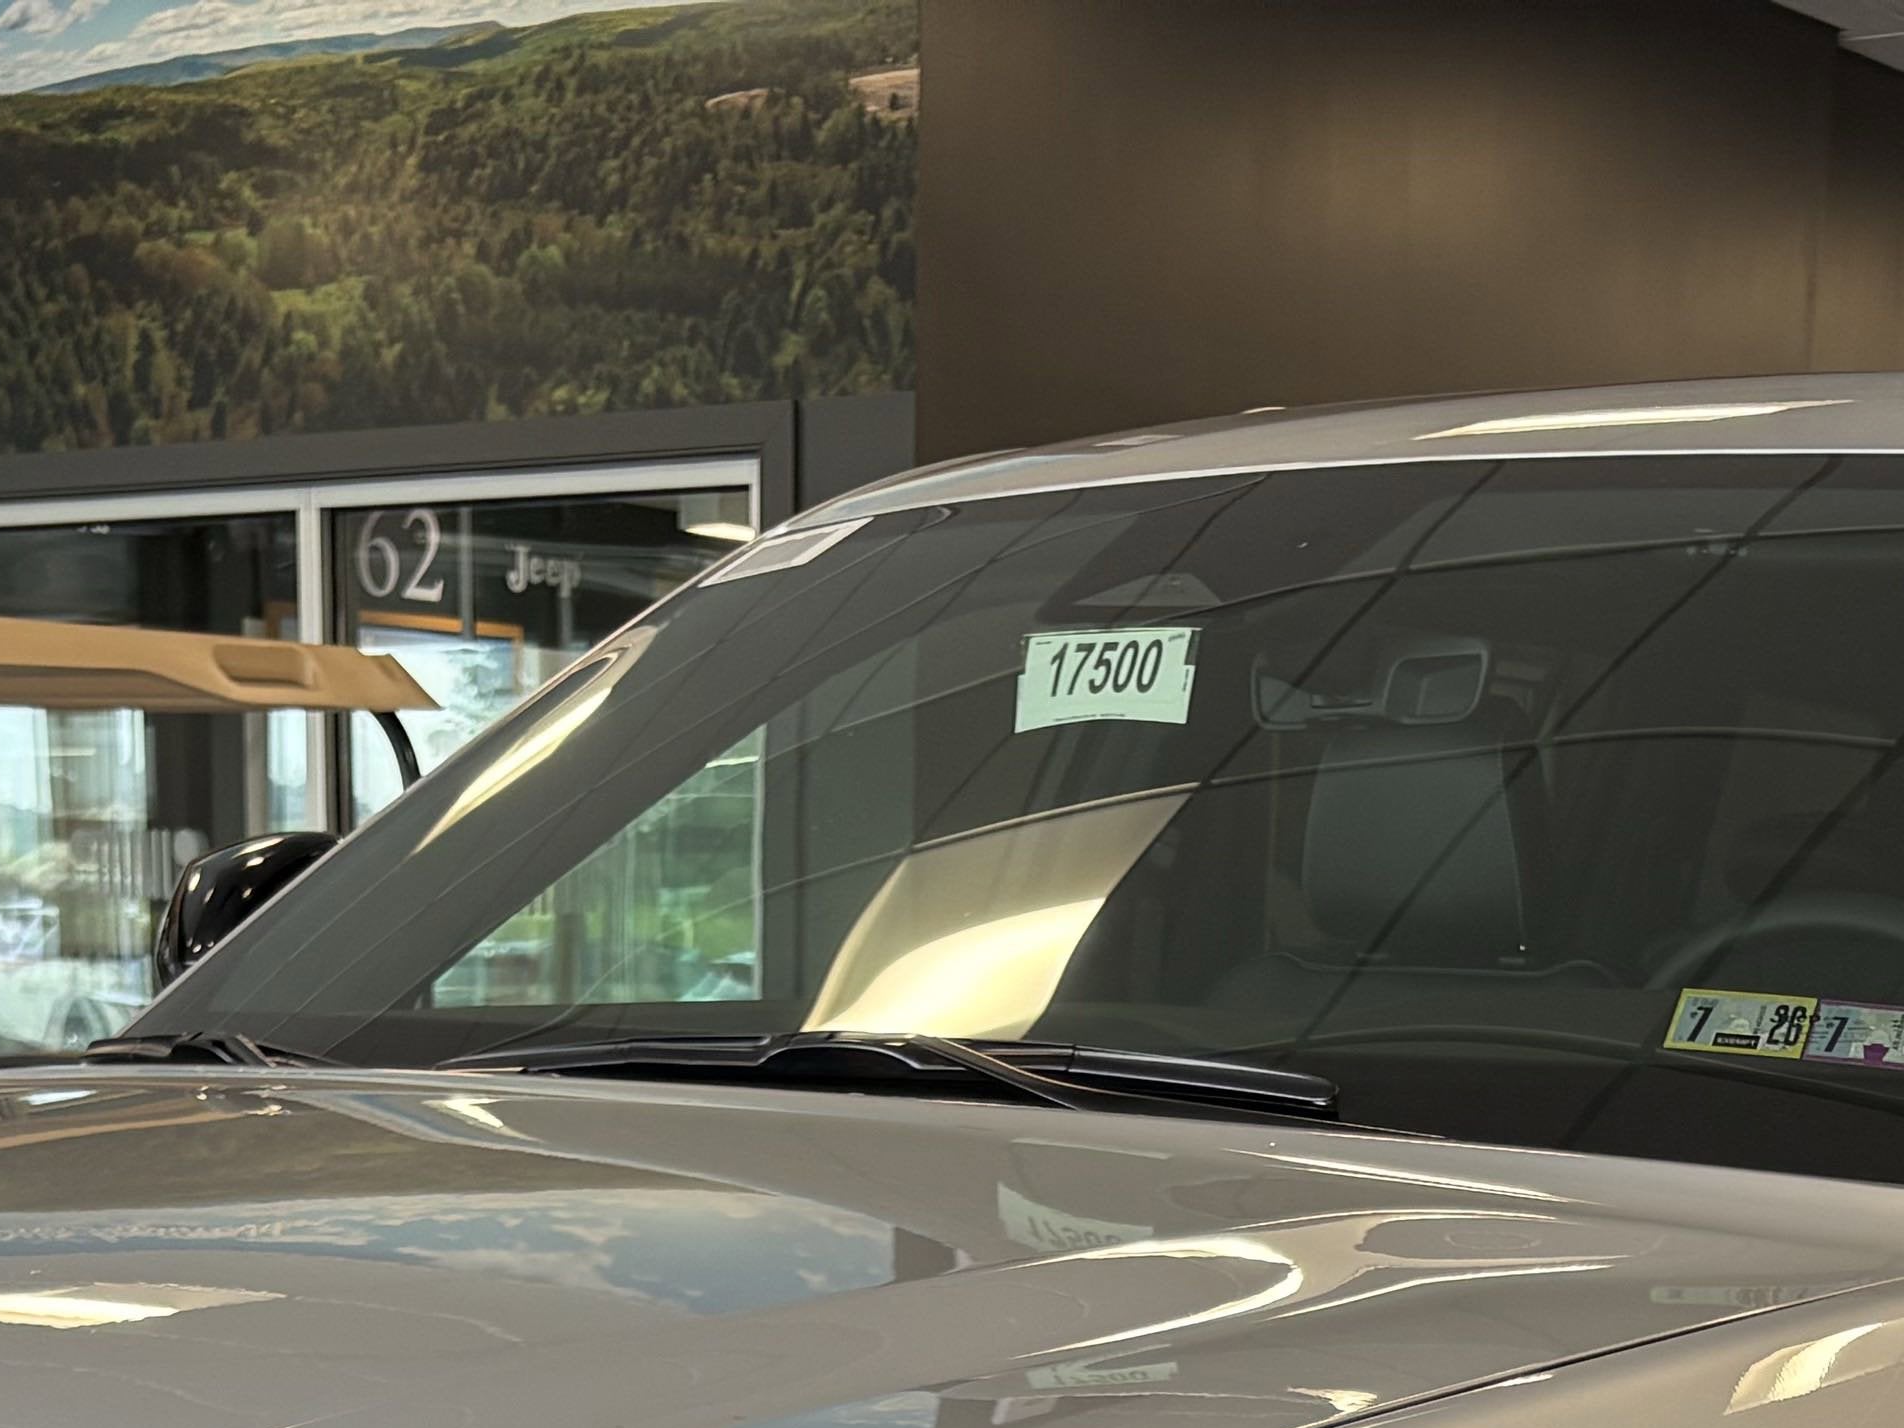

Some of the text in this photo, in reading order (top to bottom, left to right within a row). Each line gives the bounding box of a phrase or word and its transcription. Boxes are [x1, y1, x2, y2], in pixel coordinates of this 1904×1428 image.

[356, 508, 445, 603] 62
[504, 544, 583, 599] Jeep
[1049, 638, 1164, 698] 17500
